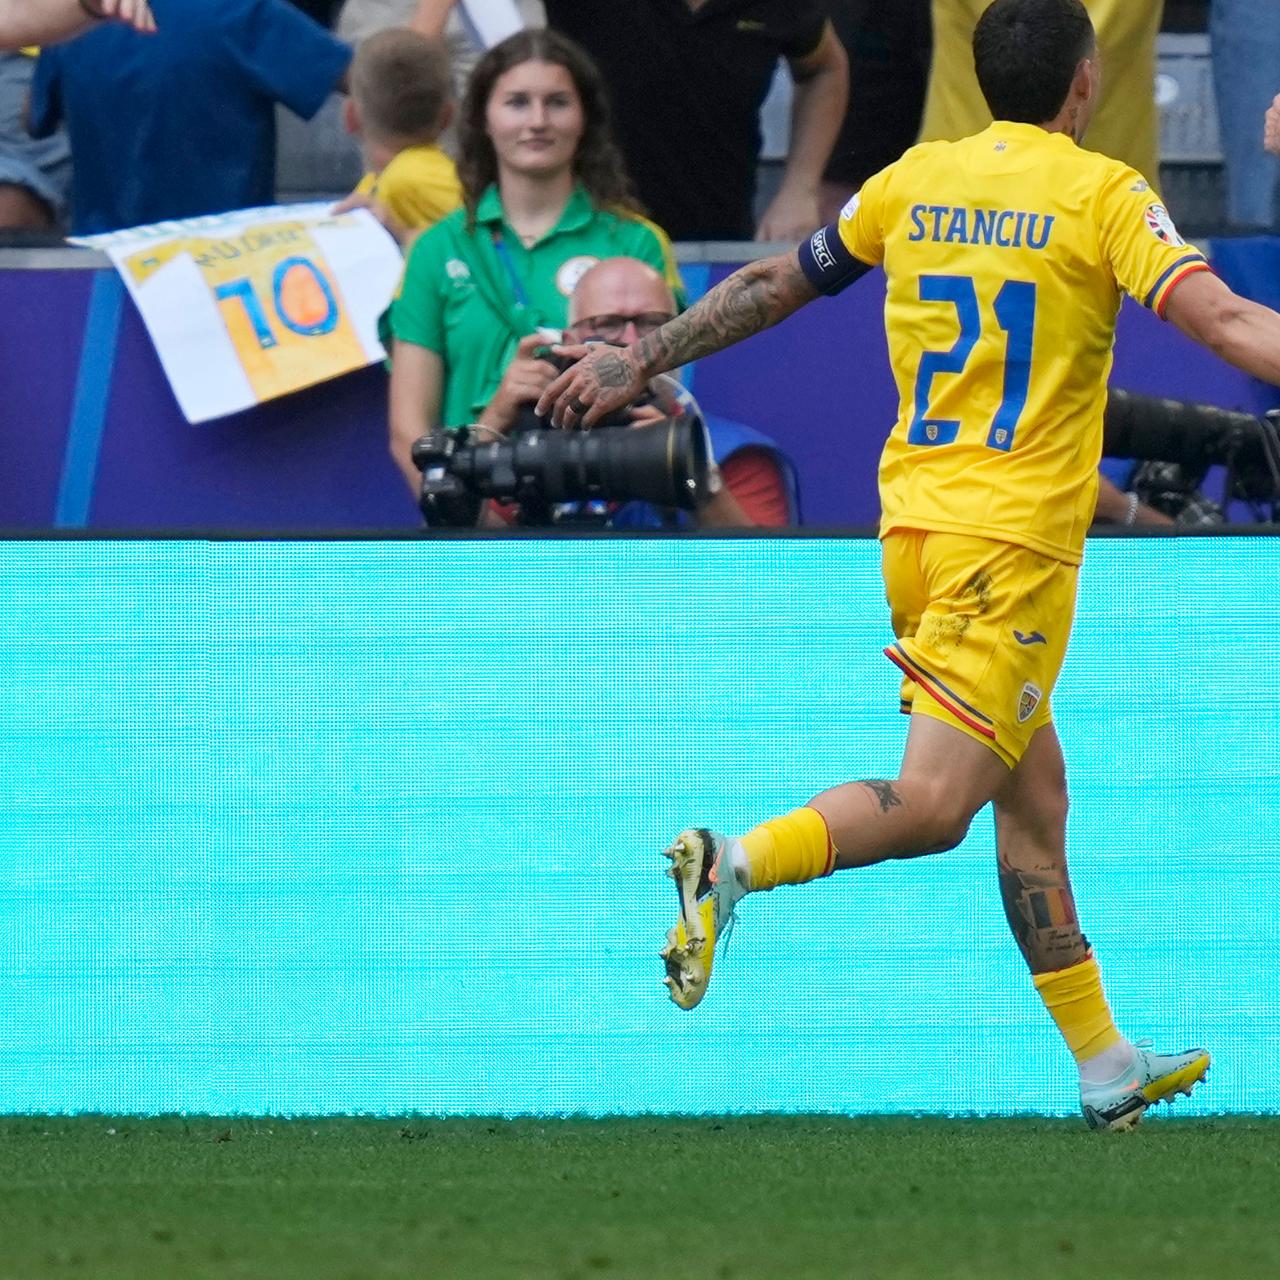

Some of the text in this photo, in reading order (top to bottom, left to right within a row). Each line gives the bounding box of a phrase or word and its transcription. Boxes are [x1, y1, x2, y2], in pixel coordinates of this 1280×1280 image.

[908, 203, 1056, 251] STANCIU
[214, 255, 340, 350] 10
[907, 274, 1037, 453] 21
